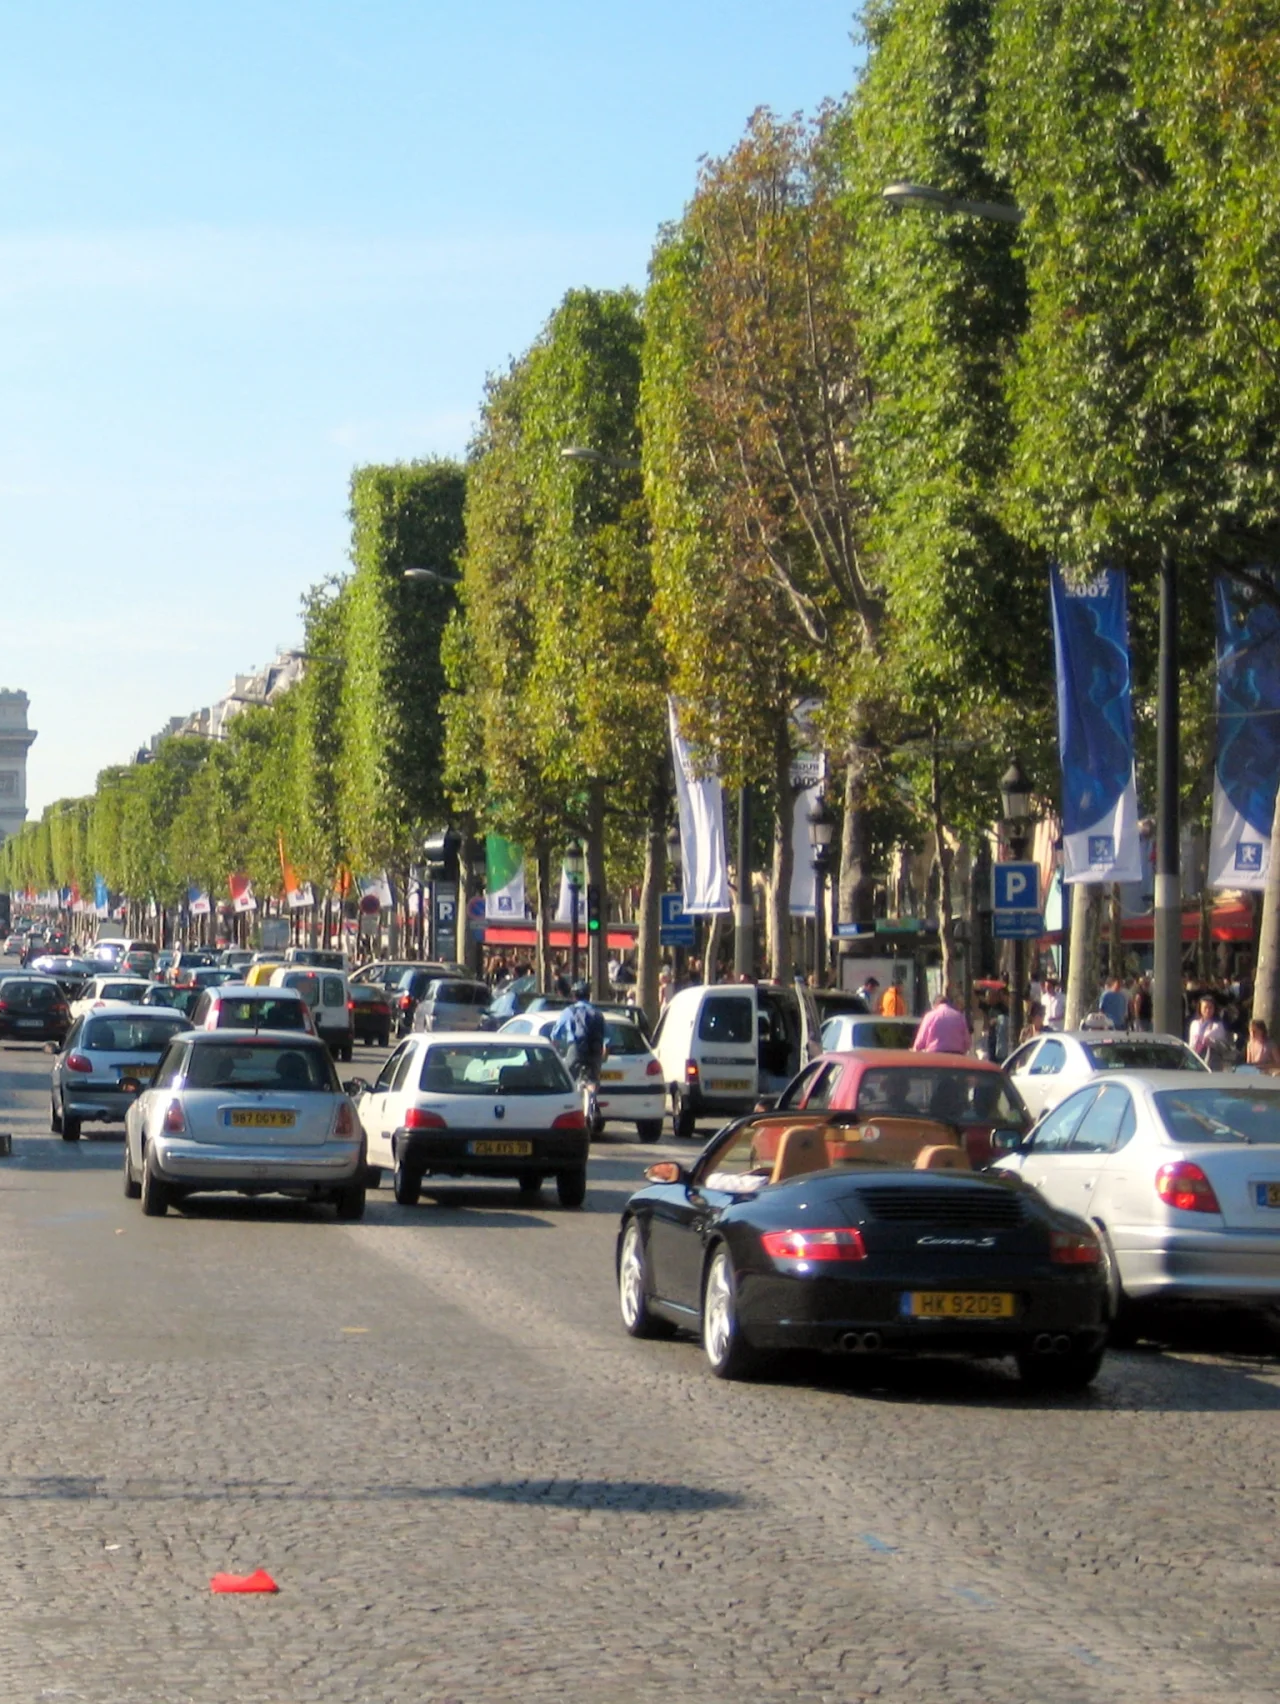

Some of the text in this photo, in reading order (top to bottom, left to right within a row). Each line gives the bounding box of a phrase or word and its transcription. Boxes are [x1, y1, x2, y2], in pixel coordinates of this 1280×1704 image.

[1006, 871, 1027, 902] P
[669, 900, 684, 921] P
[864, 1127, 875, 1138] A
[976, 1236, 996, 1246] S
[921, 1295, 1003, 1314] HK 9209
